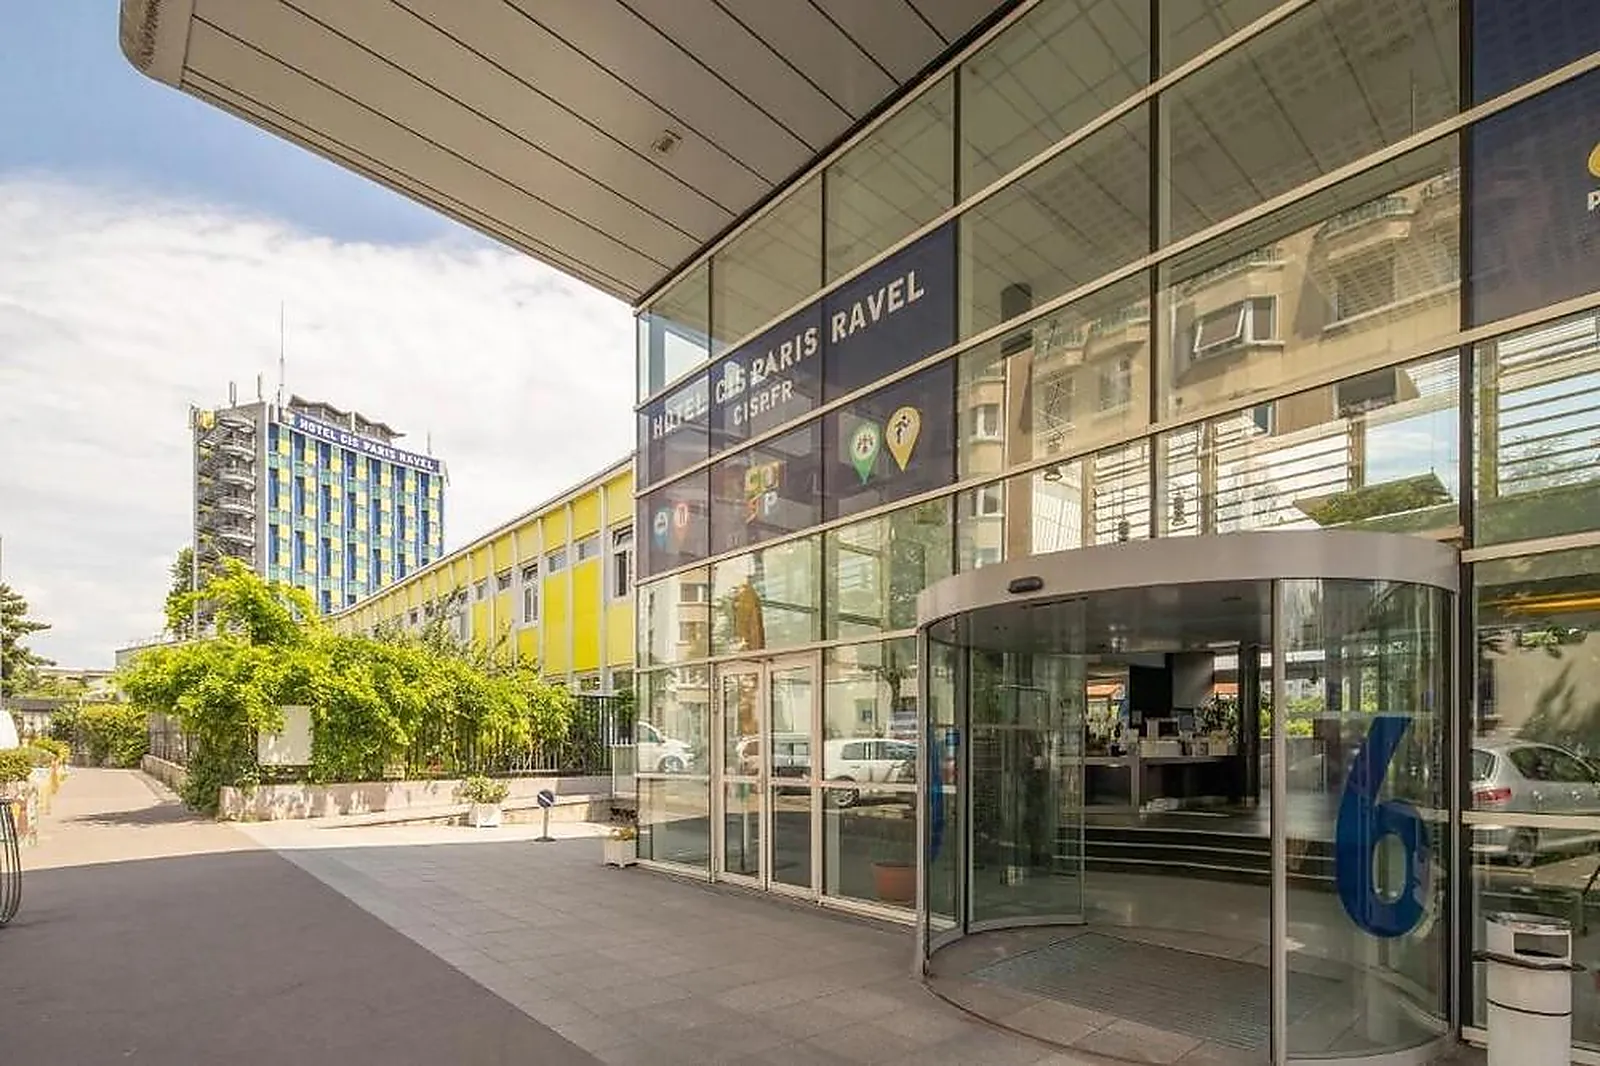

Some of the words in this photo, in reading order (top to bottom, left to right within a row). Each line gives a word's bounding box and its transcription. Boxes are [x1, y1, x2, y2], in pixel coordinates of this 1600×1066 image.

[751, 327, 818, 386] PARIS
[831, 269, 924, 343] RAVEL
[300, 418, 337, 440] HOTEL
[341, 435, 359, 447] CIS
[364, 441, 396, 459] PARIS
[399, 451, 434, 469] RAVEL
[1336, 716, 1435, 938] 6
